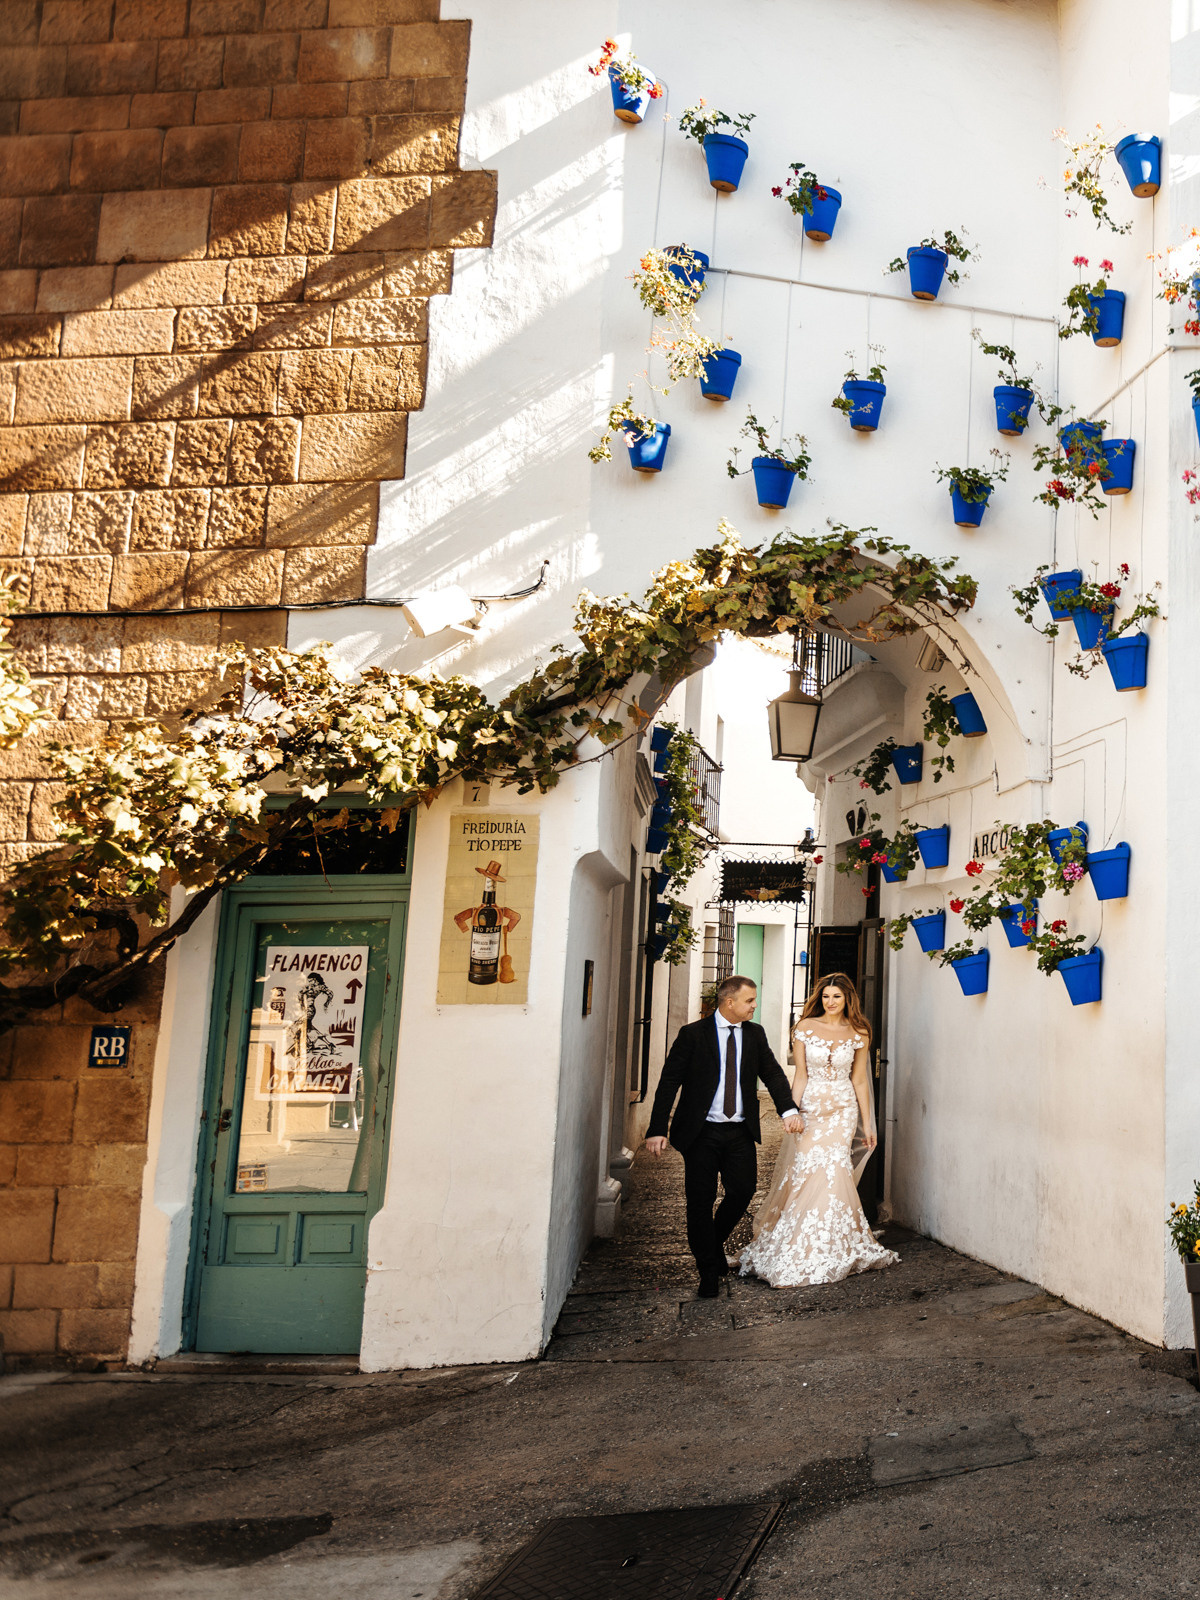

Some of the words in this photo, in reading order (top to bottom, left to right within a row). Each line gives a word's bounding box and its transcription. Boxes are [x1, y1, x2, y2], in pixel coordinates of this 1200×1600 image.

[491, 839, 522, 852] PEPE
[271, 953, 363, 973] FLAMENCO
[93, 1036, 125, 1057] RB
[266, 1073, 349, 1092] CARMEN
